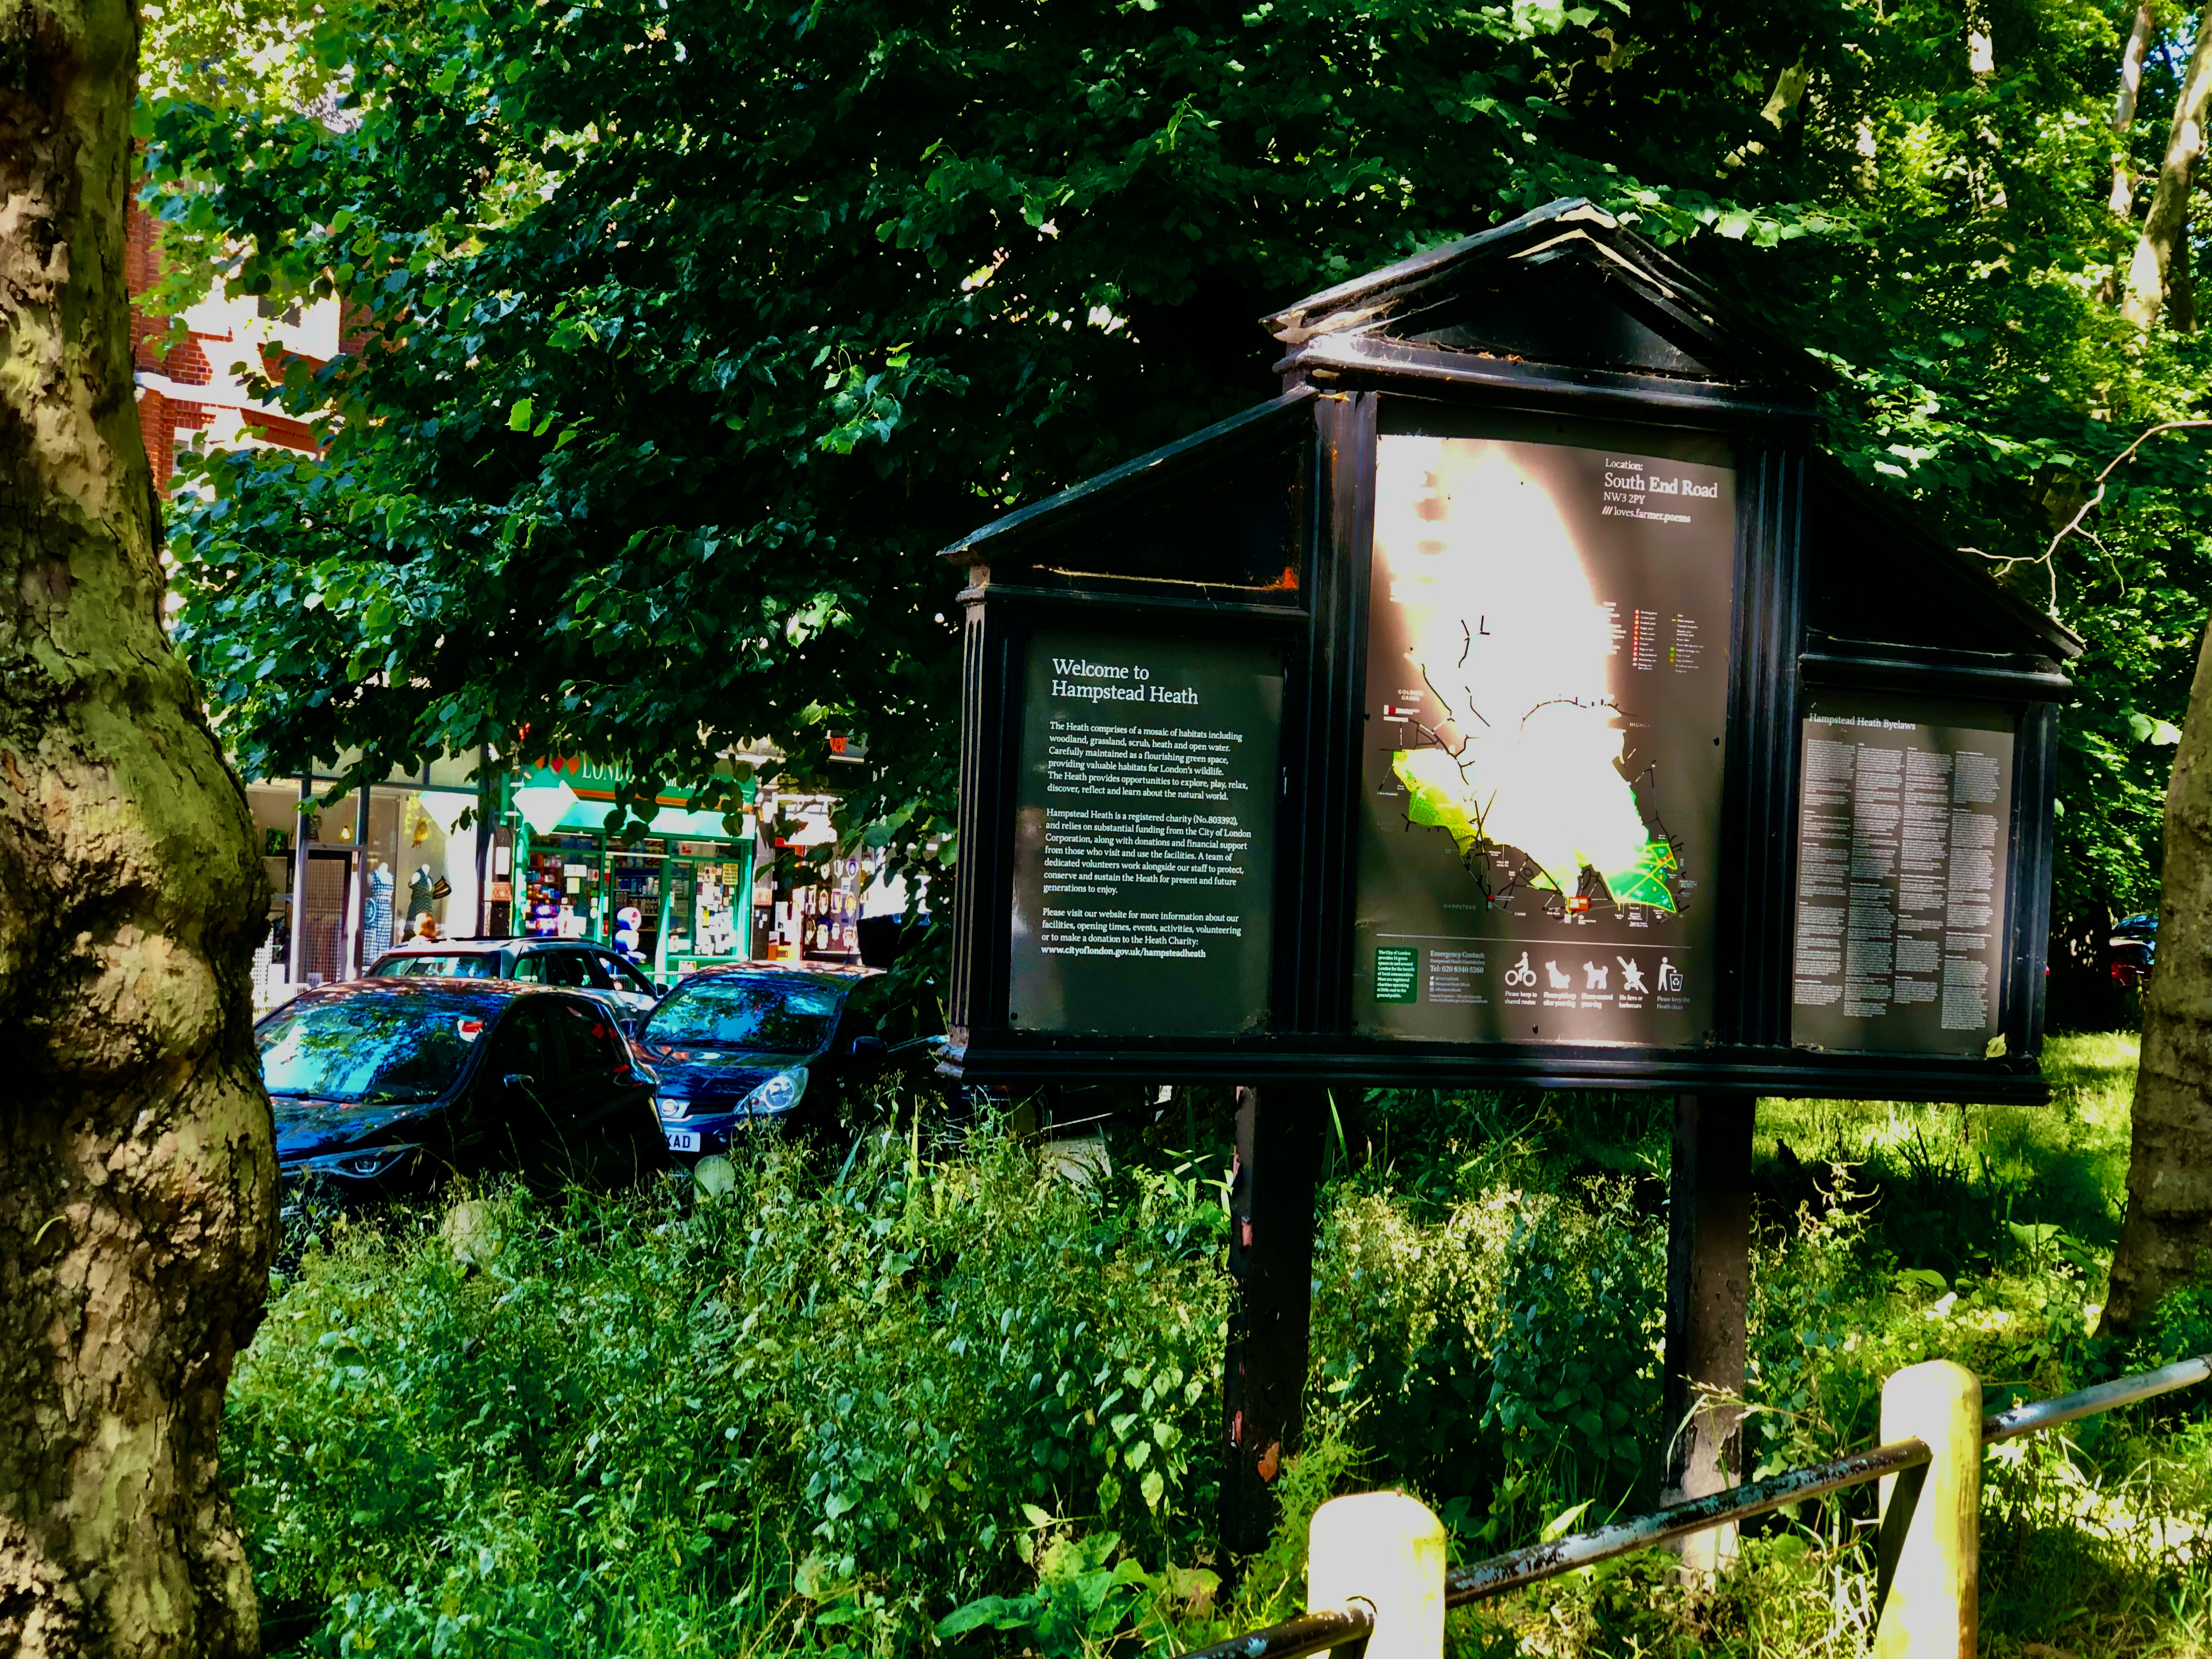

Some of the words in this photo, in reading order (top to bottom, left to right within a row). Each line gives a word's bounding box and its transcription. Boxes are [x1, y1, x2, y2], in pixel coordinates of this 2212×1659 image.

[1606, 458, 1643, 470] Location:
[1605, 472, 1645, 490] South
[1649, 476, 1678, 494] End
[1681, 479, 1717, 498] Road
[1604, 492, 1626, 502] NW3
[1629, 494, 1645, 504] 2PY
[1052, 658, 1128, 679] Welcome
[1133, 665, 1149, 680] to
[1052, 680, 1144, 703] Hampstead
[1149, 686, 1198, 704] Heath
[1809, 713, 1855, 726] Hampstead
[1857, 716, 1881, 727] Heath
[1883, 719, 1916, 730] Byelaws
[1050, 721, 1064, 730] The
[1066, 722, 1088, 731] Heath
[1091, 725, 1127, 735] comprises
[1128, 726, 1137, 734] of
[1143, 728, 1169, 736] mosaic
[1170, 728, 1177, 736] of
[1178, 729, 1206, 738] habitats
[1208, 731, 1242, 743] including
[1049, 735, 1088, 744] woodland,
[1090, 737, 1126, 747] grassland,
[1128, 738, 1150, 748] scrub,
[1152, 739, 1172, 748] heath
[1174, 741, 1187, 749] and
[1189, 744, 1206, 752] open
[1049, 746, 1084, 758] Carefully
[1085, 749, 1127, 758] maintained
[1144, 751, 1184, 764] flourishing
[1185, 755, 1206, 764] green
[1207, 757, 1228, 765] space,
[1048, 759, 1085, 771] providing
[1086, 760, 1116, 770] valuable
[1118, 762, 1147, 771] habitats
[1148, 764, 1159, 772] for
[1194, 766, 1223, 776] wildlife.
[1048, 771, 1062, 780] The
[1064, 772, 1086, 781] Heath
[1088, 774, 1120, 783] provides
[1121, 777, 1170, 786] opportunities
[1181, 778, 1208, 788] explore,
[1210, 780, 1226, 790] play,
[1228, 781, 1248, 790] relax,
[1047, 783, 1080, 794] discover,
[1082, 785, 1105, 794] reflect
[1107, 787, 1120, 795] and
[1122, 787, 1141, 796] learn
[1142, 788, 1163, 797] about
[1164, 789, 1176, 798] the
[1178, 791, 1204, 799] natural
[1205, 792, 1228, 800] world.
[1047, 808, 1088, 819] Hampstead
[1091, 810, 1113, 819] Heath
[1115, 811, 1120, 820] is
[1128, 813, 1164, 823] registered
[1166, 814, 1192, 825] charity
[1046, 821, 1059, 829] and
[1062, 821, 1081, 830] relies
[1094, 823, 1133, 832] substantial
[1136, 825, 1164, 836] funding
[1166, 826, 1183, 834] from
[1185, 827, 1197, 835] the
[1198, 828, 1214, 838] City
[1215, 828, 1223, 836] of
[1224, 828, 1251, 838] London
[1045, 833, 1092, 844] Corporation,
[1094, 835, 1114, 847] along
[1115, 836, 1133, 845] with
[1135, 837, 1170, 847] donations
[1171, 839, 1185, 847] and
[1187, 839, 1218, 848] financial
[1220, 842, 1247, 851] support
[1045, 845, 1063, 854] from
[1065, 846, 1084, 855] those
[1086, 847, 1102, 856] who
[1104, 848, 1120, 856] visit
[1121, 849, 1135, 857] and
[1150, 850, 1162, 858] the
[1164, 850, 1196, 860] facilities.
[1198, 852, 1204, 860] A
[1224, 853, 1233, 861] of
[1045, 857, 1080, 867] dedicated
[1081, 859, 1119, 869] volunteers
[1121, 861, 1140, 870] work
[1142, 862, 1175, 873] alongside
[1191, 864, 1207, 872] staff
[1217, 866, 1244, 875] protect,
[1079, 872, 1092, 880] and
[1122, 873, 1133, 882] the
[1136, 874, 1158, 883] Heath
[1160, 874, 1170, 883] for
[1171, 877, 1197, 885] present
[1199, 876, 1212, 884] and
[1214, 877, 1237, 885] future
[1043, 884, 1086, 893] generations
[1097, 885, 1118, 895] enjoy.
[1042, 907, 1065, 916] Please
[1066, 909, 1082, 917] visit
[1098, 910, 1127, 918] website
[1128, 910, 1138, 919] for
[1161, 912, 1204, 921] information
[1205, 913, 1224, 922] about
[1042, 919, 1075, 930] facilities,
[1077, 922, 1107, 933] opening
[1109, 922, 1131, 932] times,
[1132, 924, 1158, 933] events,
[1160, 924, 1194, 934] activities,
[1196, 925, 1241, 936] volunteering
[1060, 933, 1081, 942] make
[1088, 934, 1120, 943] donation
[1131, 935, 1143, 944] the
[1144, 935, 1166, 944] Heath
[1169, 936, 1198, 947] Charity:
[1041, 946, 1206, 959] www.cityoflondon.gov.uk/hampsteadheath
[1430, 950, 1462, 958] Emergency
